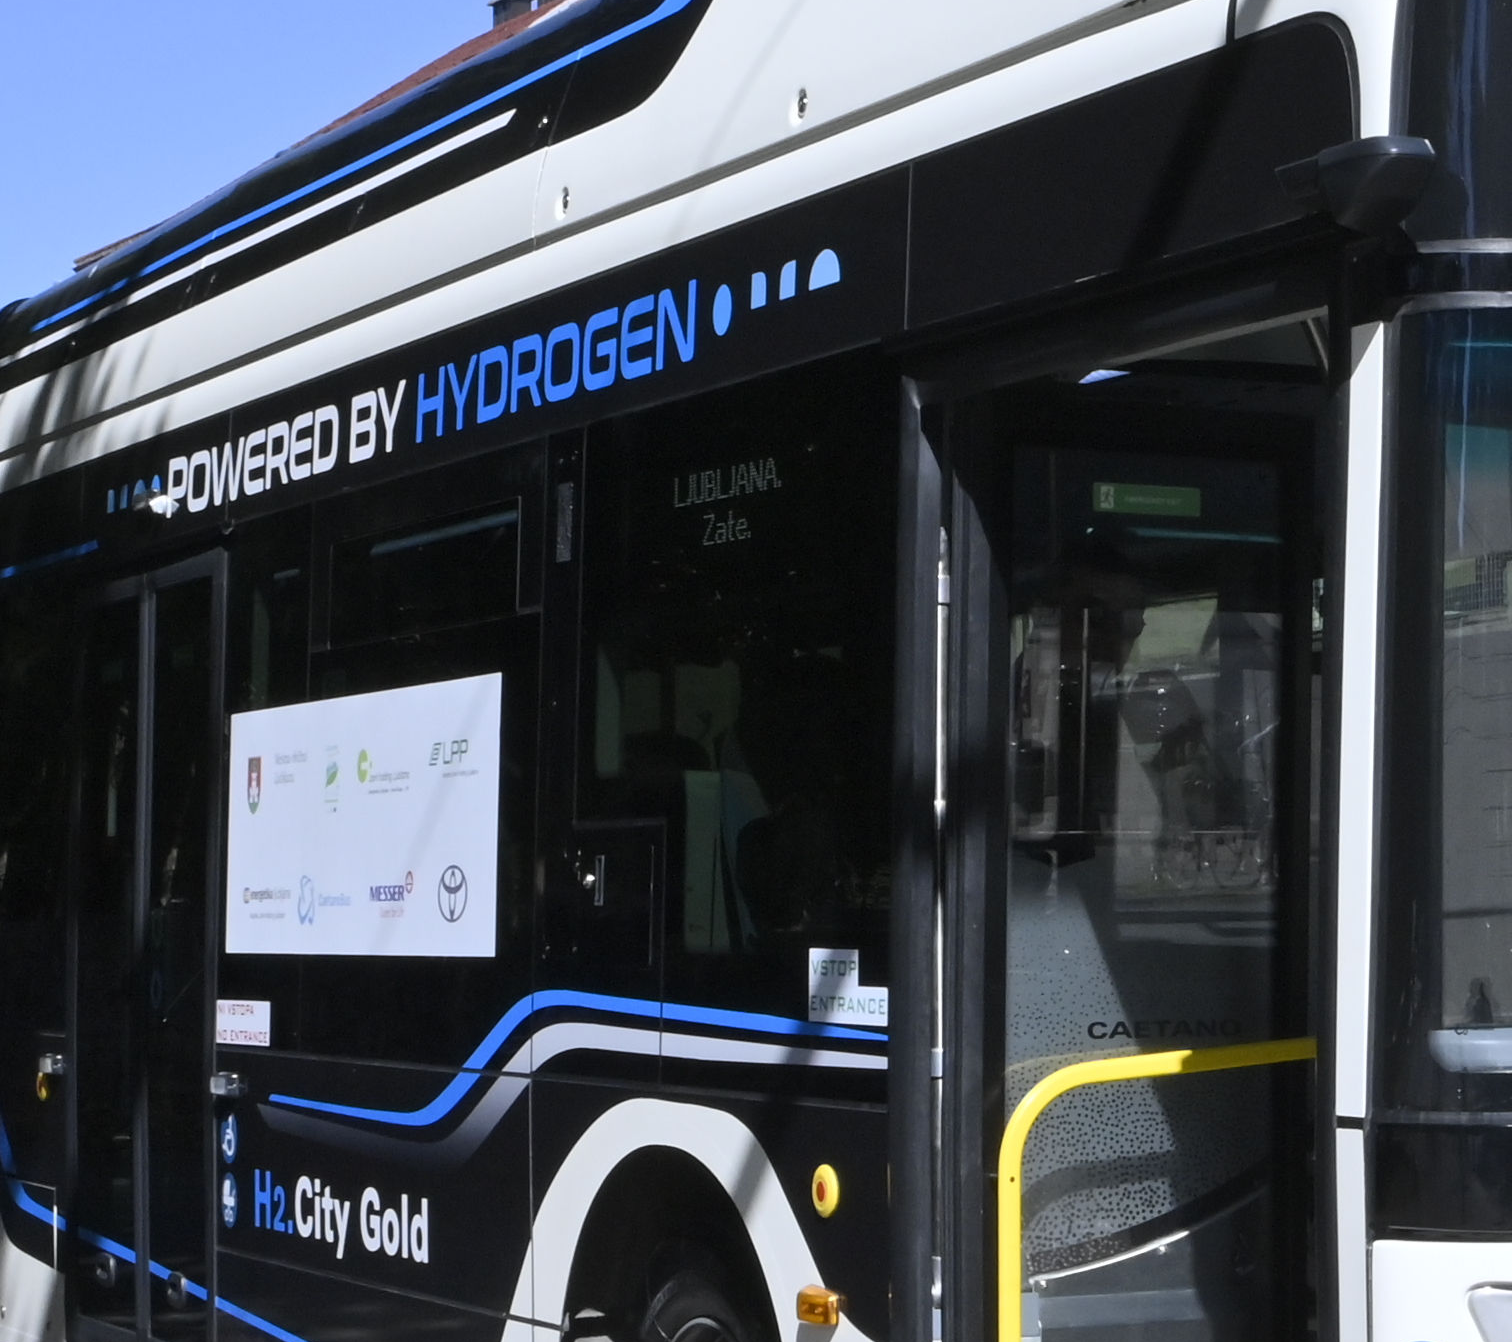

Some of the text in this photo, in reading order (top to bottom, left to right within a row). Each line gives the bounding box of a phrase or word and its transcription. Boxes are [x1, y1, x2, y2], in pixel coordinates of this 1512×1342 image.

[165, 278, 697, 519] POWERED BY HYDROGEN
[369, 885, 405, 903] MESSER
[810, 958, 857, 977] VSTOP
[810, 995, 887, 1016] ENTRANCE
[229, 1030, 269, 1045] ENTRANCE
[1086, 1018, 1243, 1041] CAETANO
[359, 1185, 430, 1264] Gold
